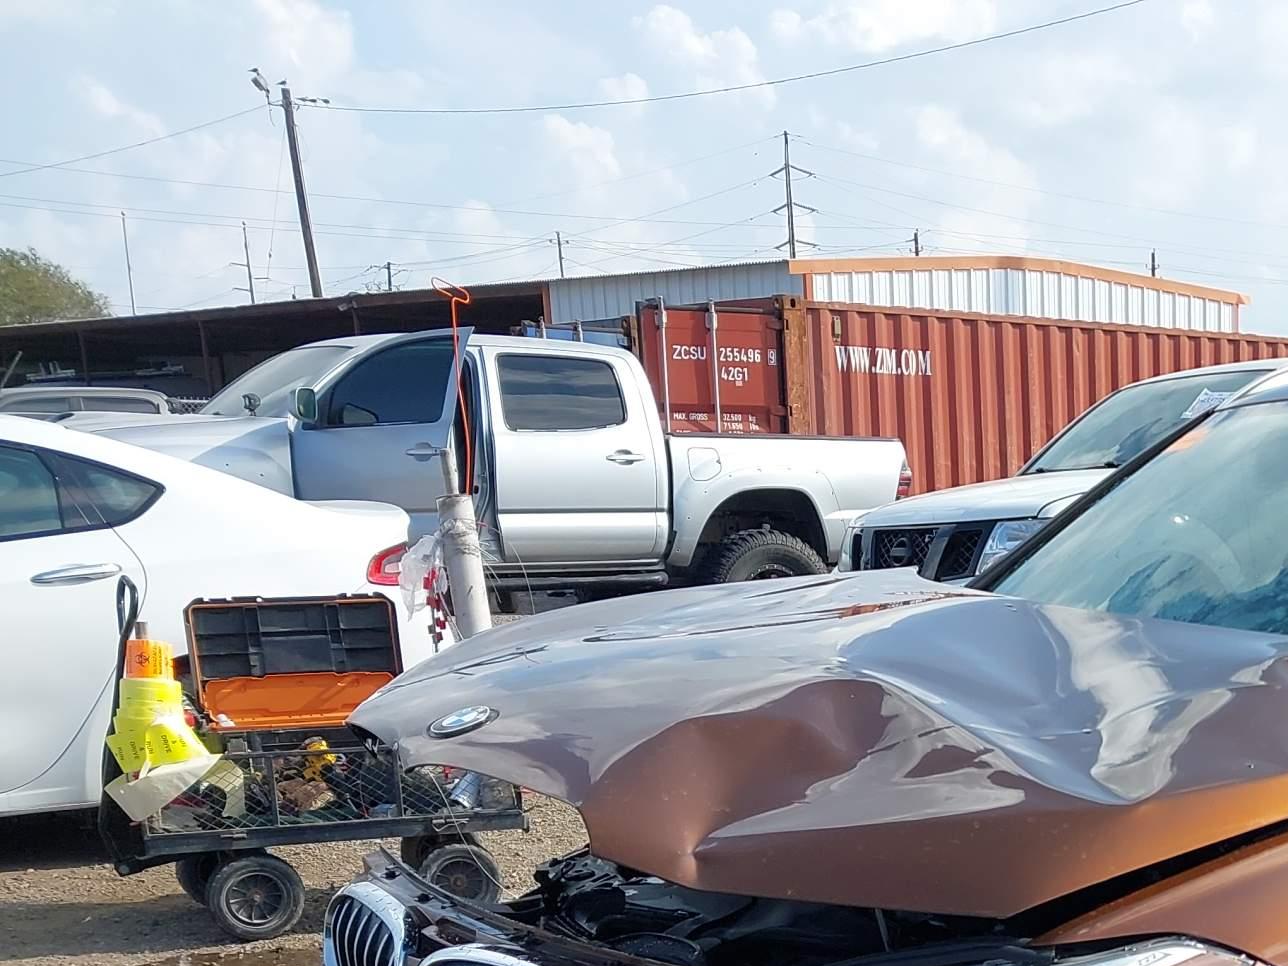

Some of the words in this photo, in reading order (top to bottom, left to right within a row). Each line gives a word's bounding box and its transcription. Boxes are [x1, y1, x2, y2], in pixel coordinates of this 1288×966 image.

[672, 345, 706, 360] ZCSU
[720, 348, 761, 363] 255496
[769, 350, 775, 364] 9
[721, 366, 748, 381] 42G1
